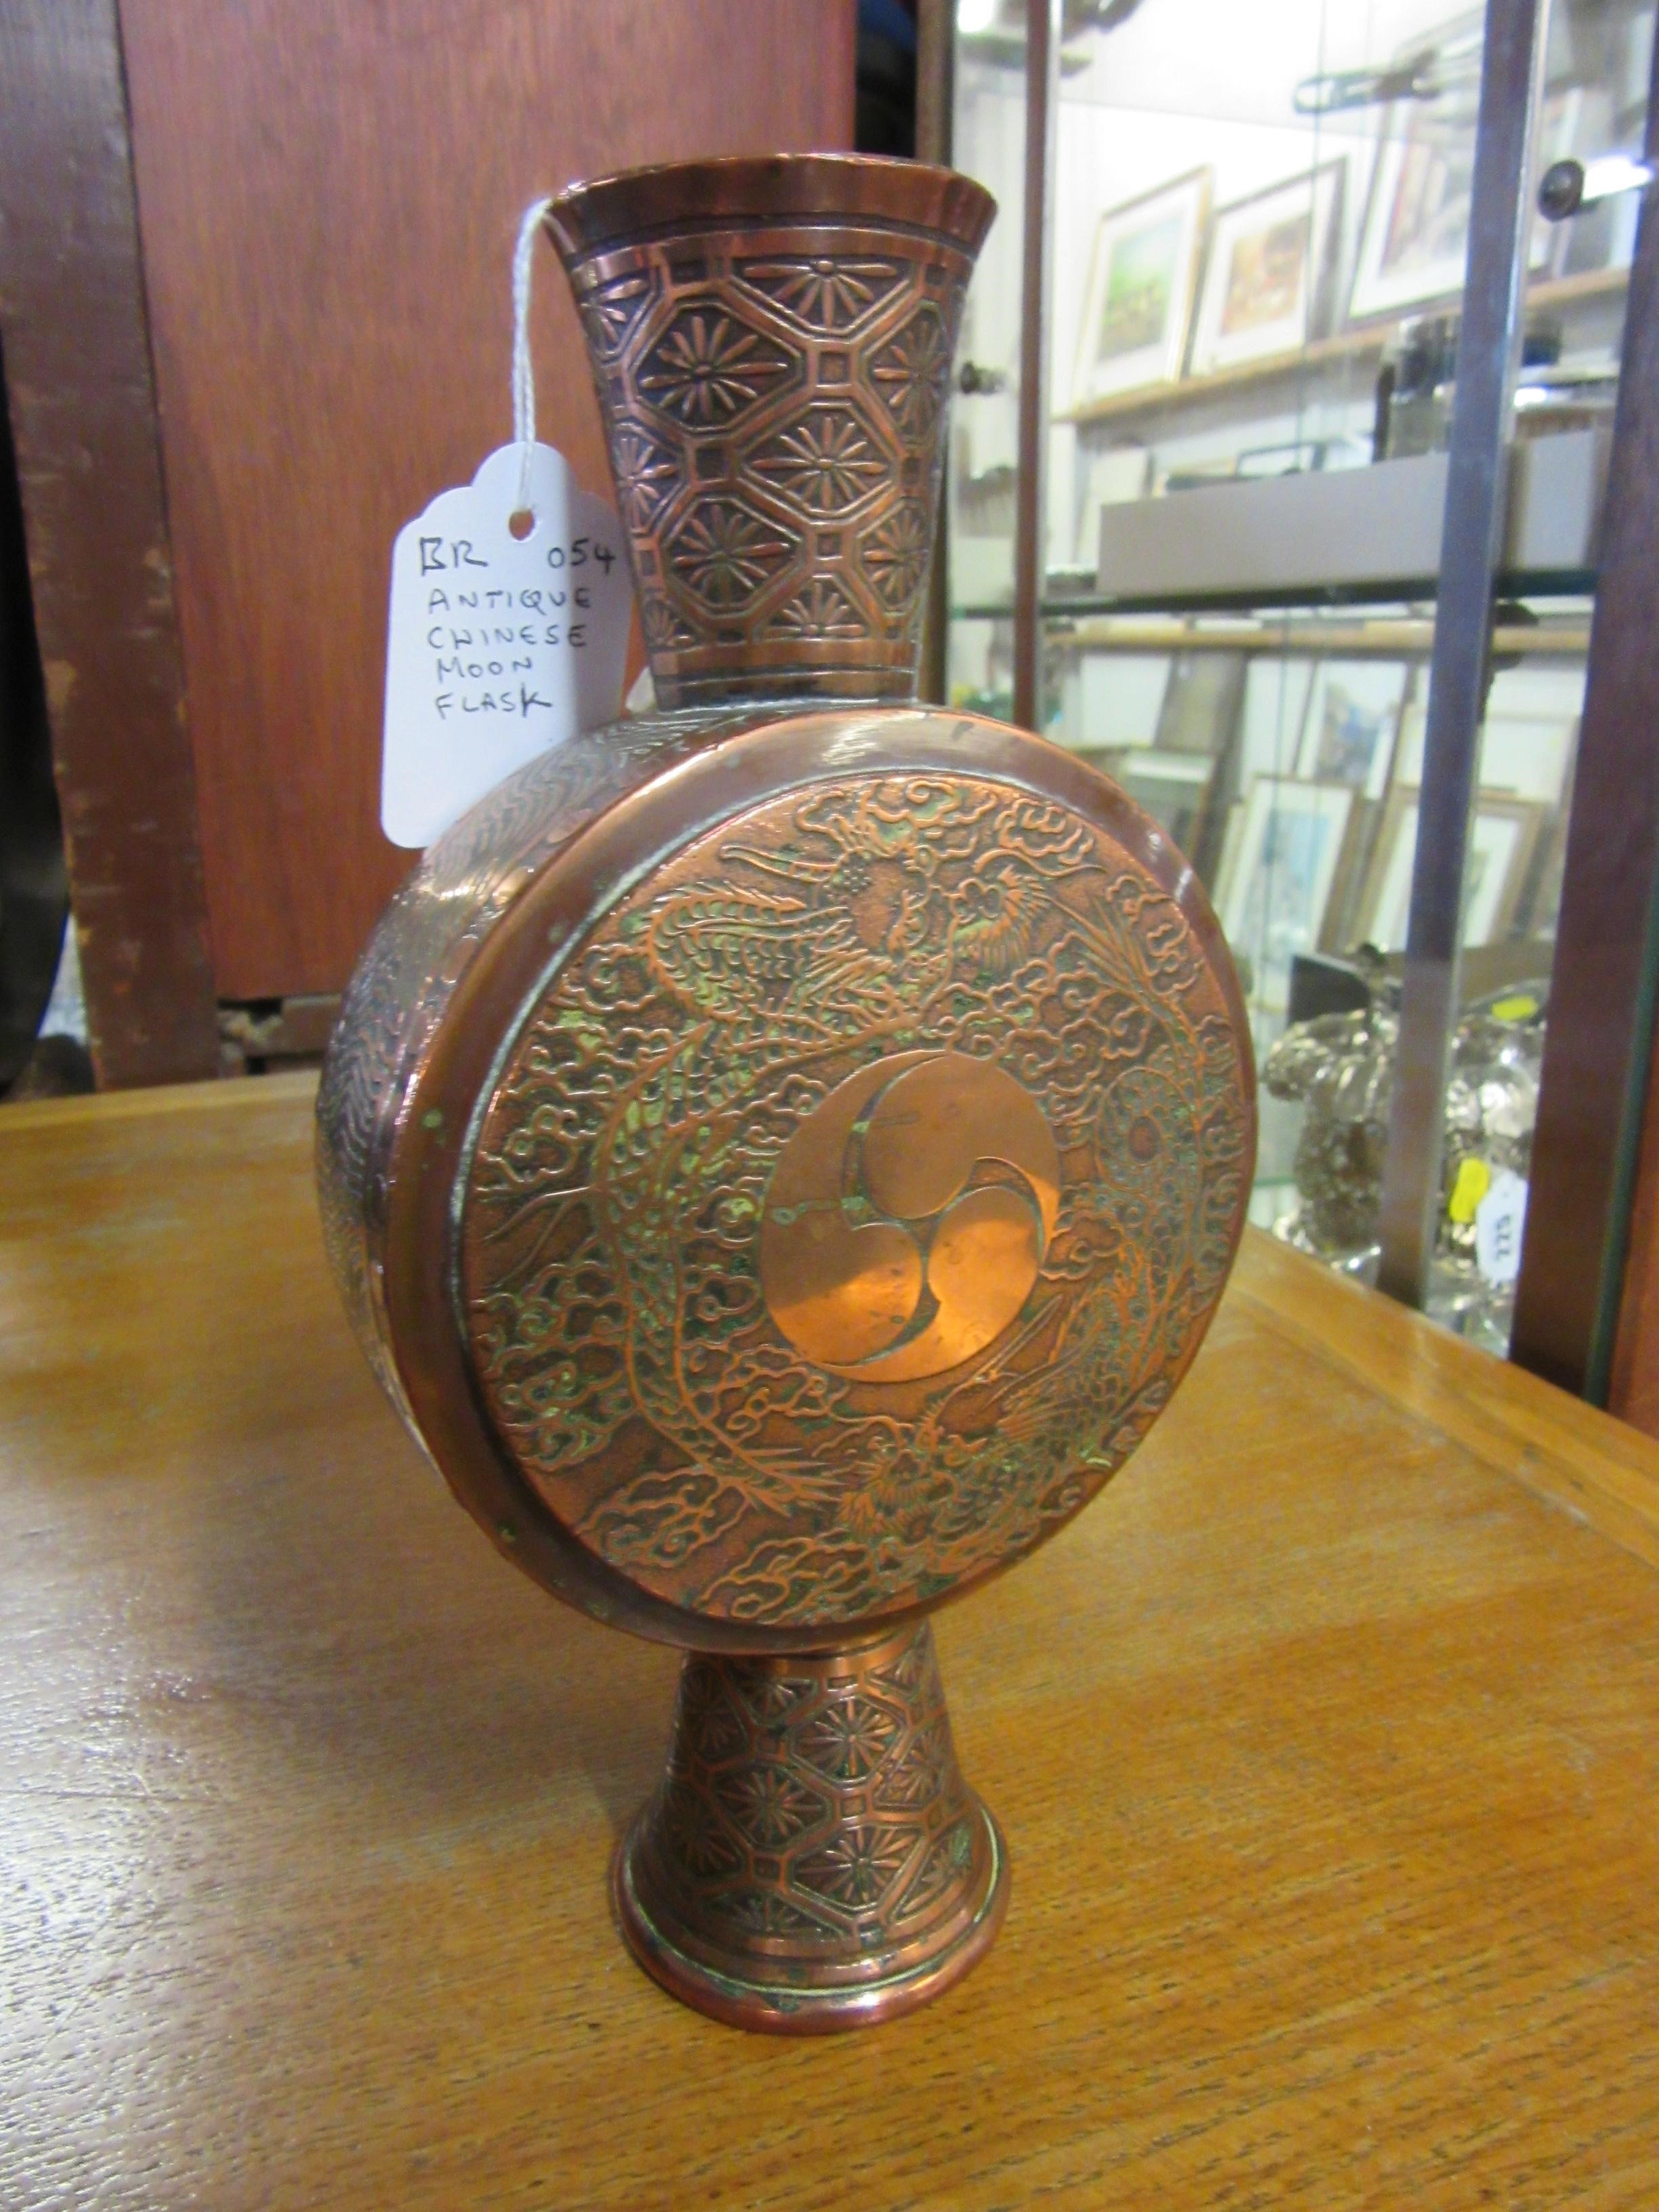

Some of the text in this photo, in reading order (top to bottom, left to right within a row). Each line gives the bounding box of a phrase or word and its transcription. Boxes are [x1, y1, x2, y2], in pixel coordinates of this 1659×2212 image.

[419, 537, 615, 576] BR 054
[428, 588, 591, 615] ANTIQUE
[428, 625, 587, 651] CHINESE
[437, 656, 532, 682] MOON
[435, 682, 552, 720] FLASK
